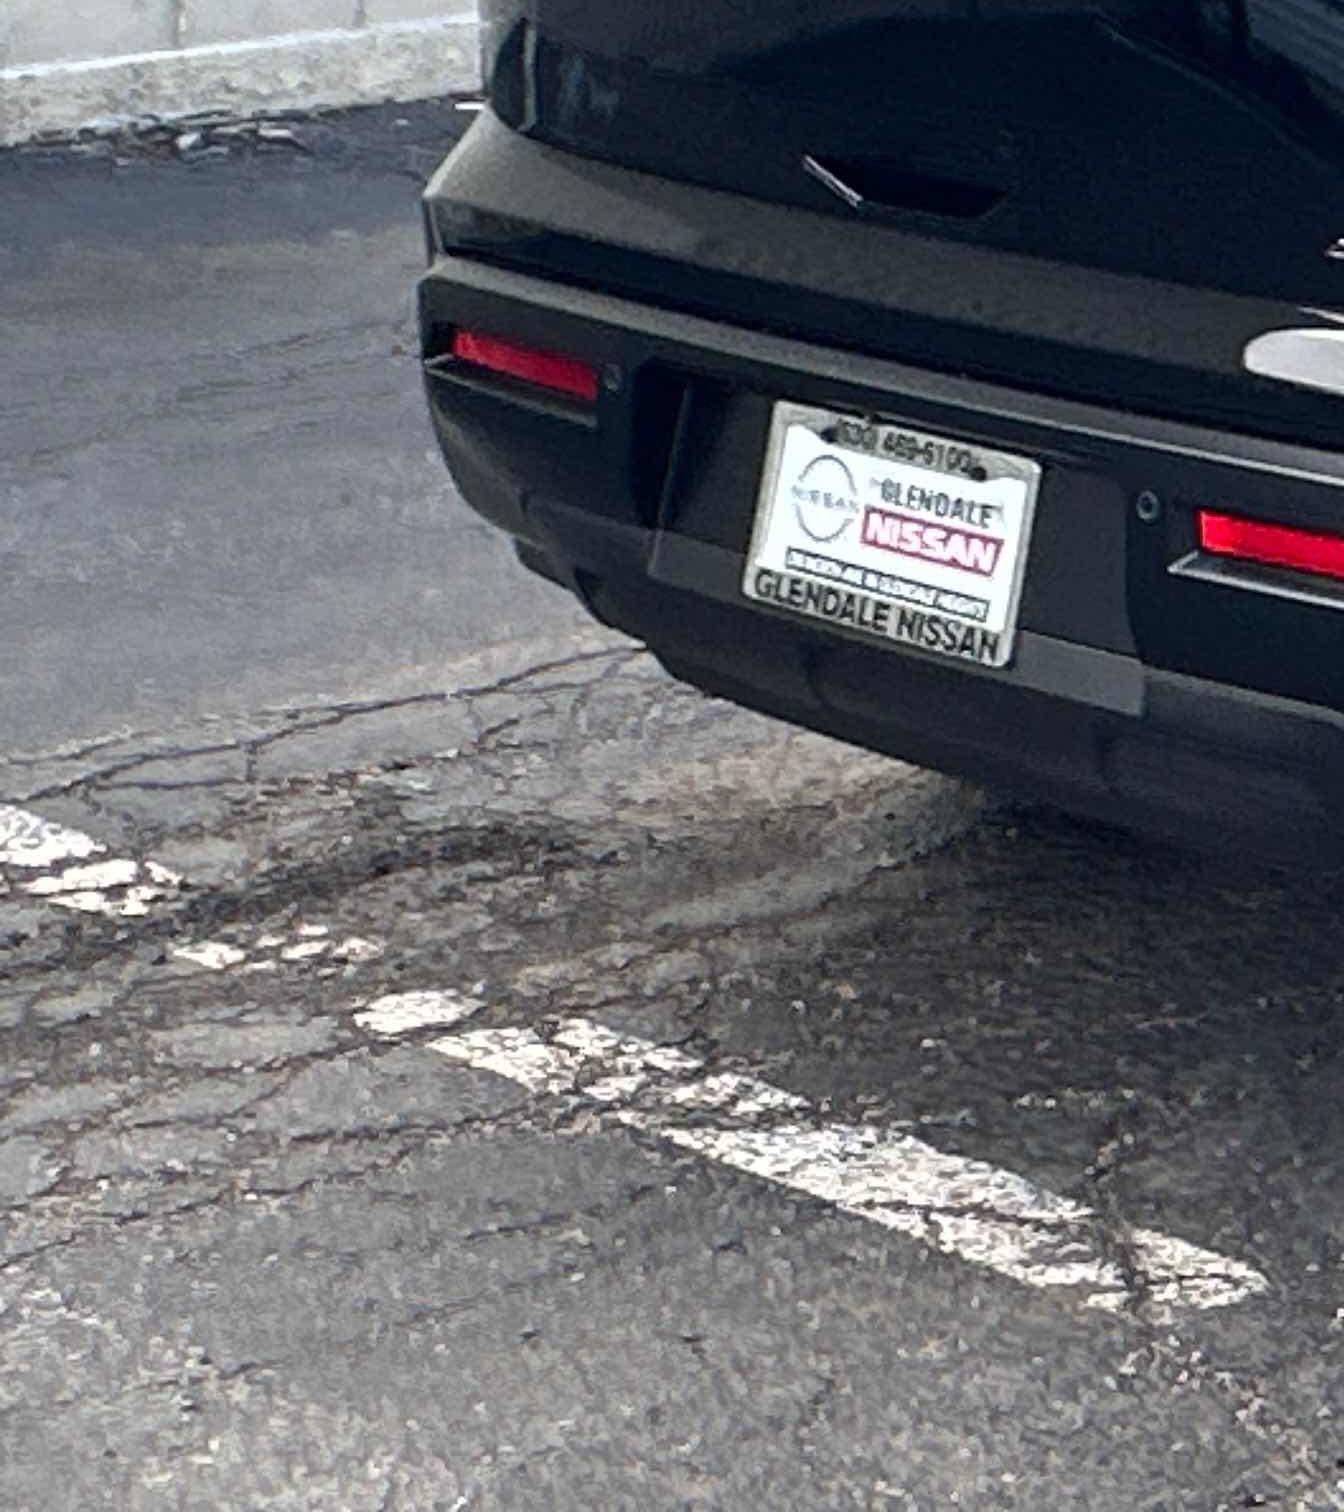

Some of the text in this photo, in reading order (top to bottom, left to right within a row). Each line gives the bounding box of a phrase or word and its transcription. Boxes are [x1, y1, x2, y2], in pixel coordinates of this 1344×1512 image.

[881, 478, 995, 527] GLENDALE
[863, 510, 1000, 573] NISSAN
[753, 569, 891, 633] GLENDALE
[896, 607, 1000, 663] NISSAN
